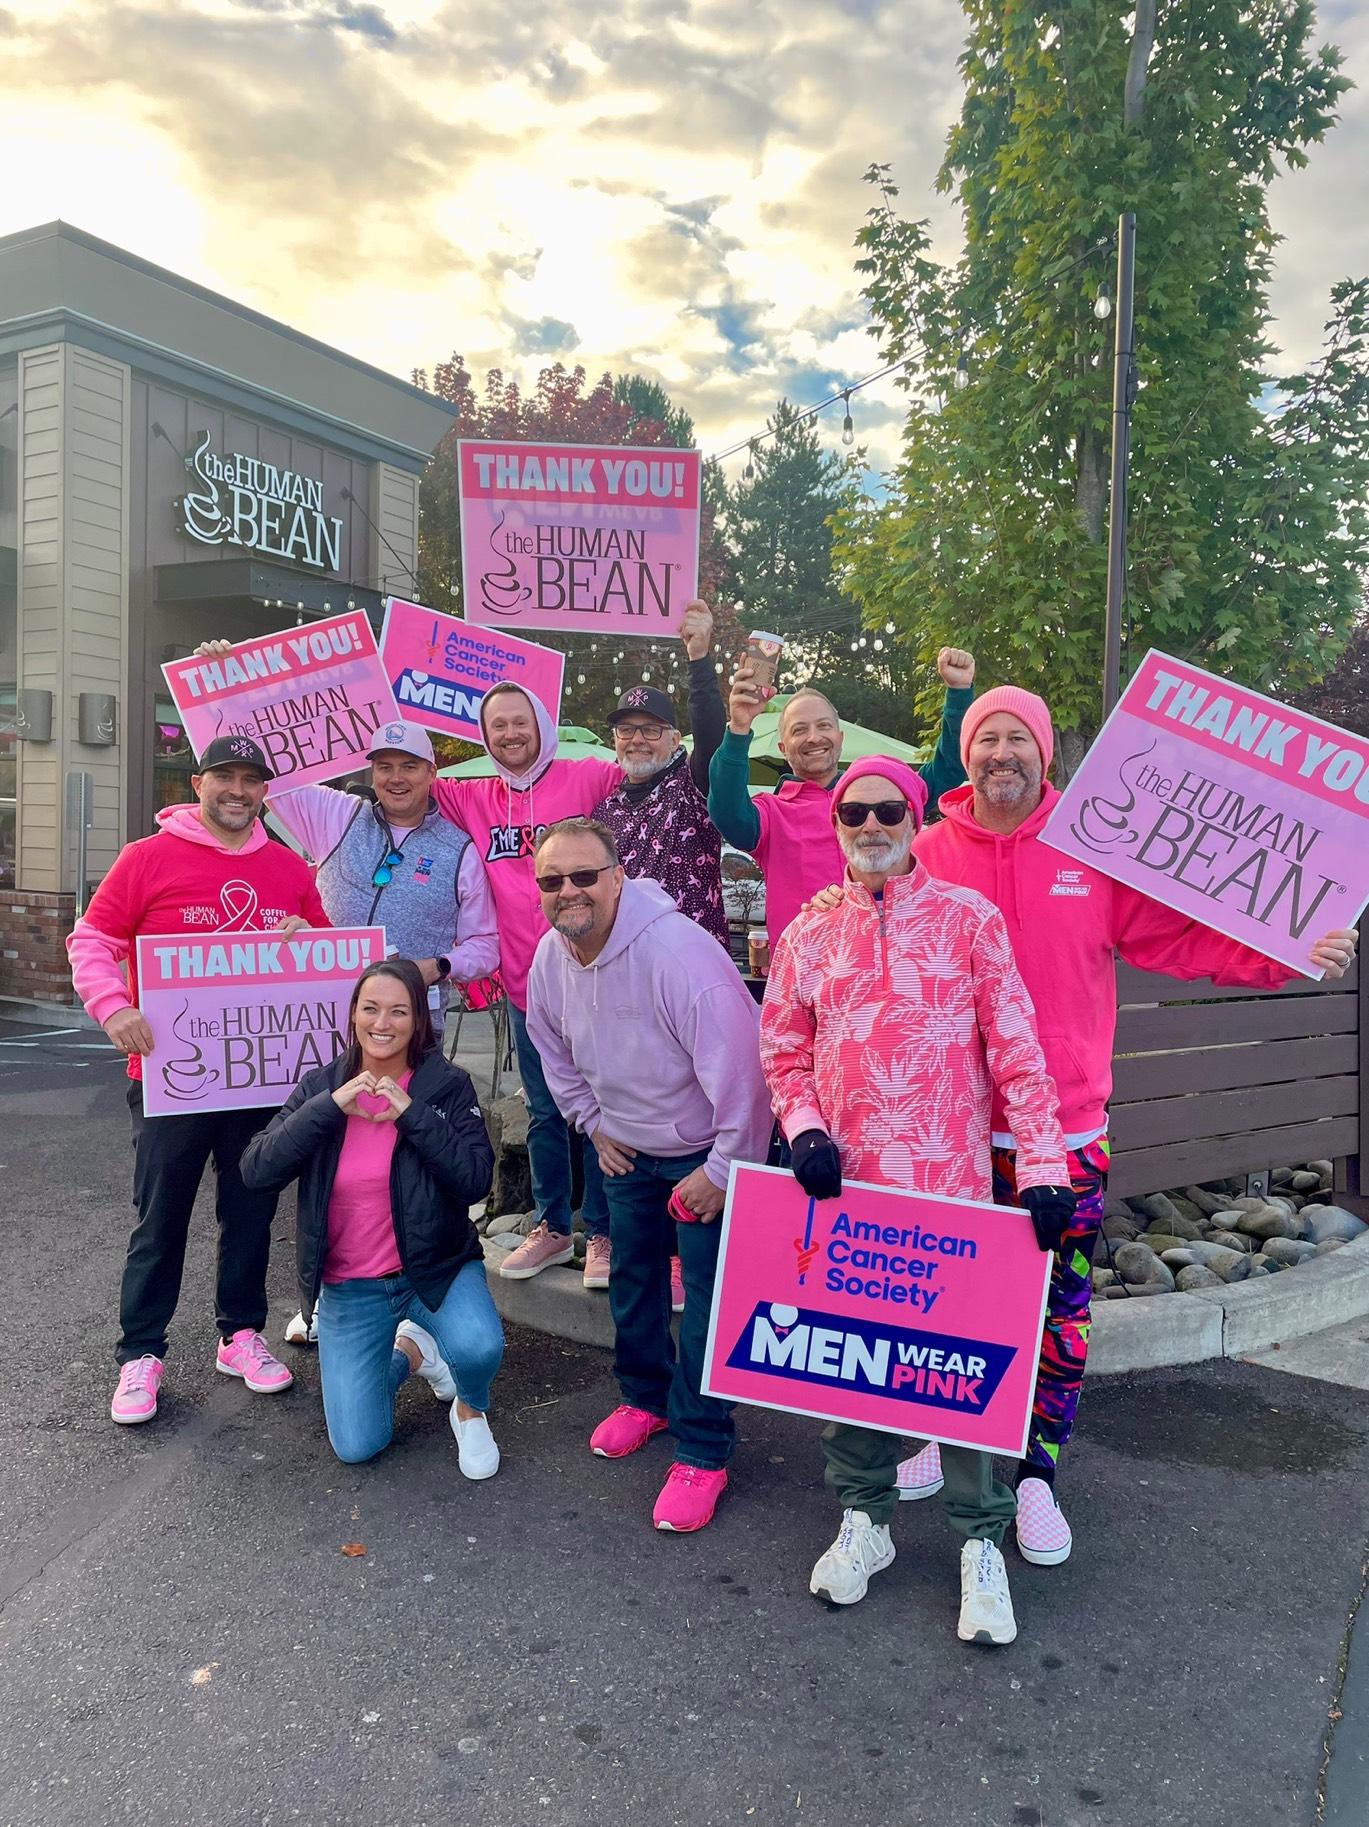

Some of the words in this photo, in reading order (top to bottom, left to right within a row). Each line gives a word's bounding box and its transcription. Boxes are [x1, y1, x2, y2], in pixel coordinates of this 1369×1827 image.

[230, 452, 323, 512] HUMAN
[473, 453, 596, 494] THANK
[601, 459, 685, 498] YOU!
[228, 484, 343, 571] BEAN
[534, 524, 648, 560] HUMAN
[178, 642, 291, 698] THANK
[288, 622, 363, 667] YOU!
[444, 644, 506, 672] Cancer
[446, 631, 526, 666] American
[251, 683, 350, 735] HUMAN
[399, 674, 484, 720] MEN
[1145, 670, 1302, 767] THANK
[1166, 769, 1324, 862] HUMAN
[183, 911, 219, 925] BEAN
[260, 909, 287, 917] COFFEE
[263, 916, 279, 924] FOR
[154, 941, 284, 980] THANK
[290, 938, 371, 973] YOU!
[220, 1002, 337, 1037] HUMAN
[831, 1212, 977, 1259] American
[827, 1240, 939, 1280] Cancer
[826, 1268, 939, 1314] Society
[750, 1316, 891, 1387] MEN
[897, 1342, 987, 1379] WEAR
[892, 1364, 985, 1405] PINK
